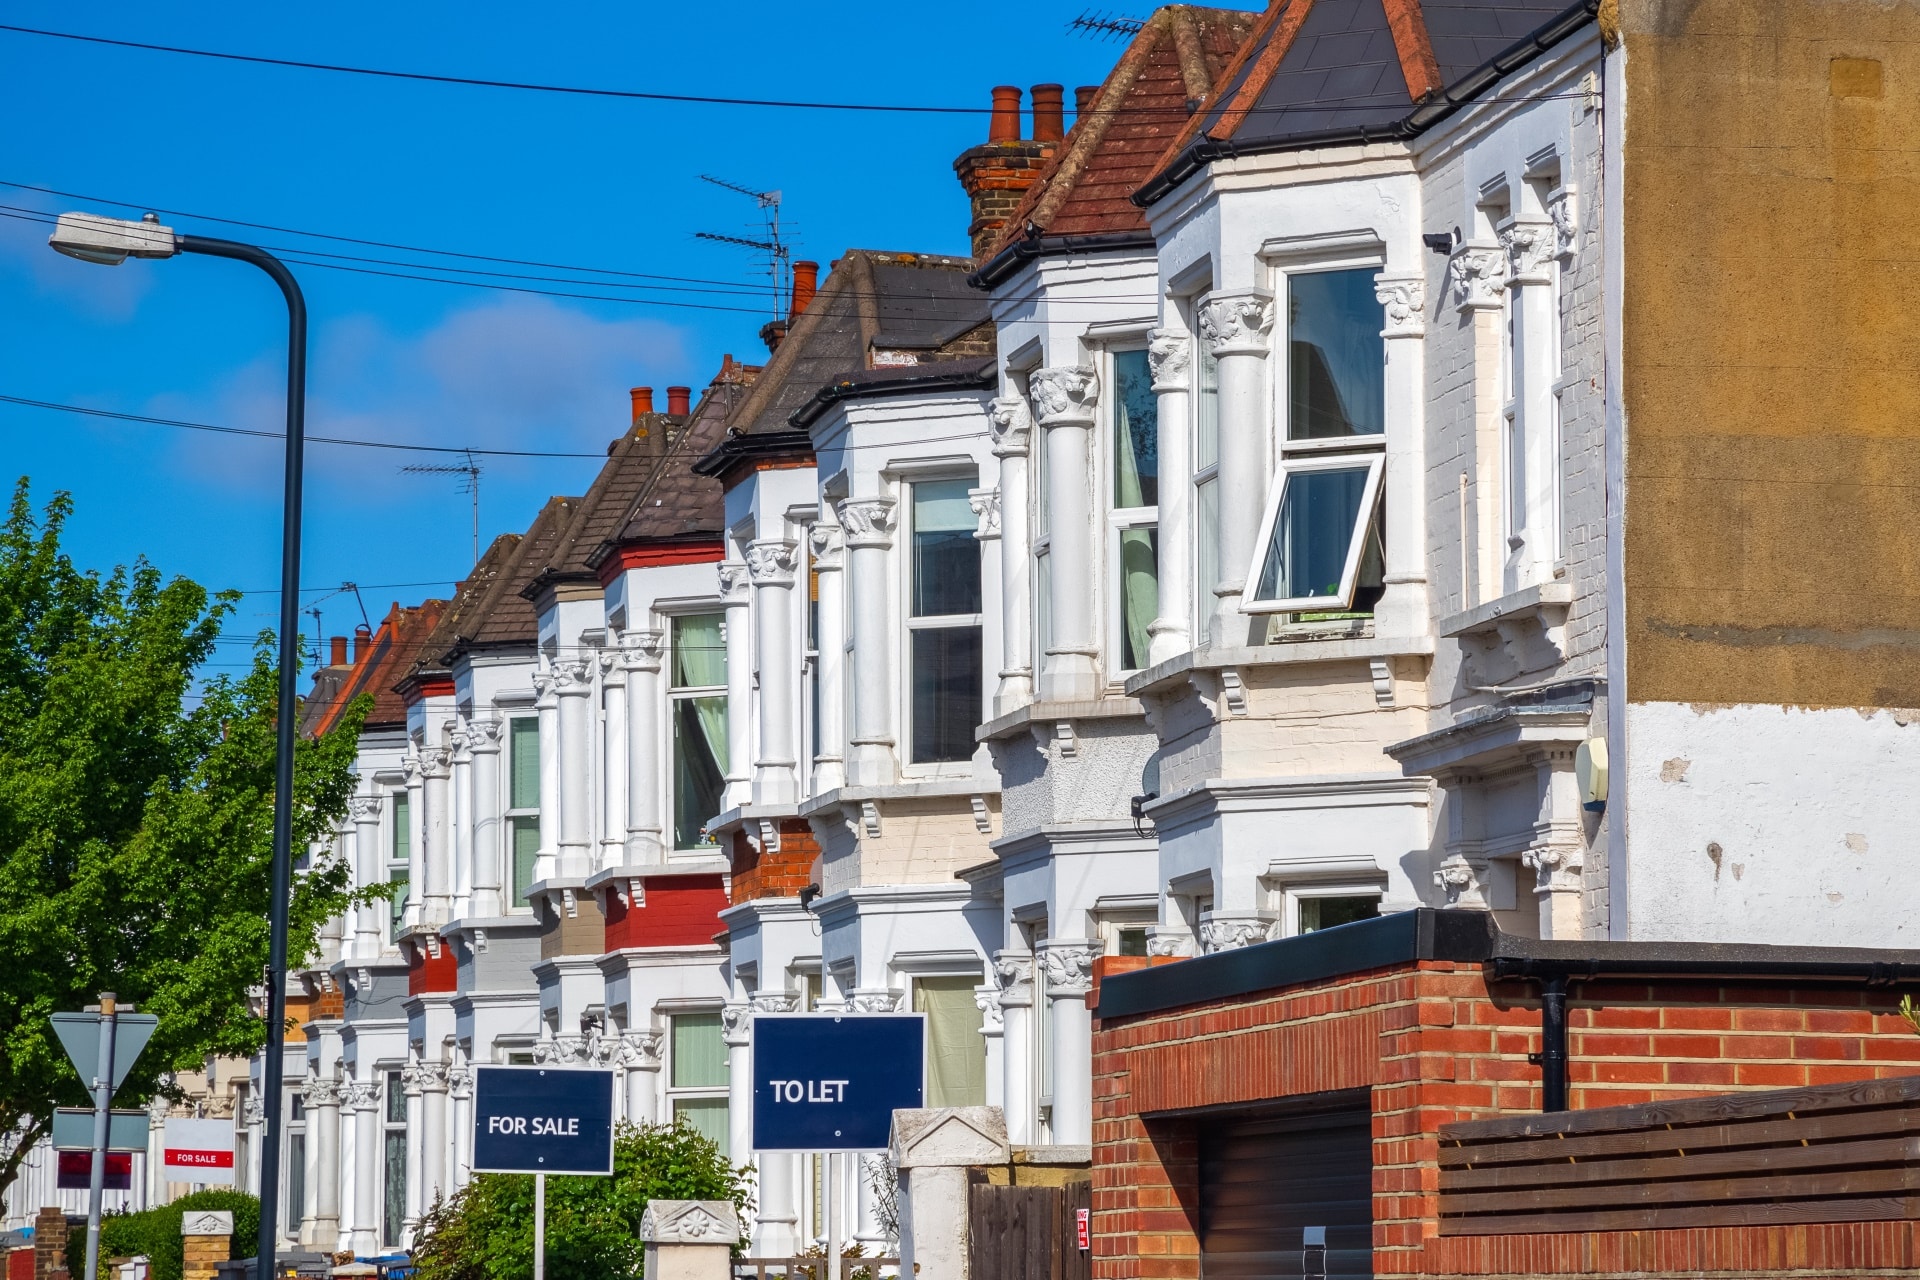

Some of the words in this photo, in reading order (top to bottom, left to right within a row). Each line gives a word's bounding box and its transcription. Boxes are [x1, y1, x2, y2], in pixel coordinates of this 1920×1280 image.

[769, 1080, 803, 1103] TO
[808, 1080, 849, 1103] LET
[488, 1117, 526, 1135] FOR
[531, 1117, 579, 1136] SALE
[177, 1154, 193, 1163] FOR
[195, 1154, 217, 1164] SALE
